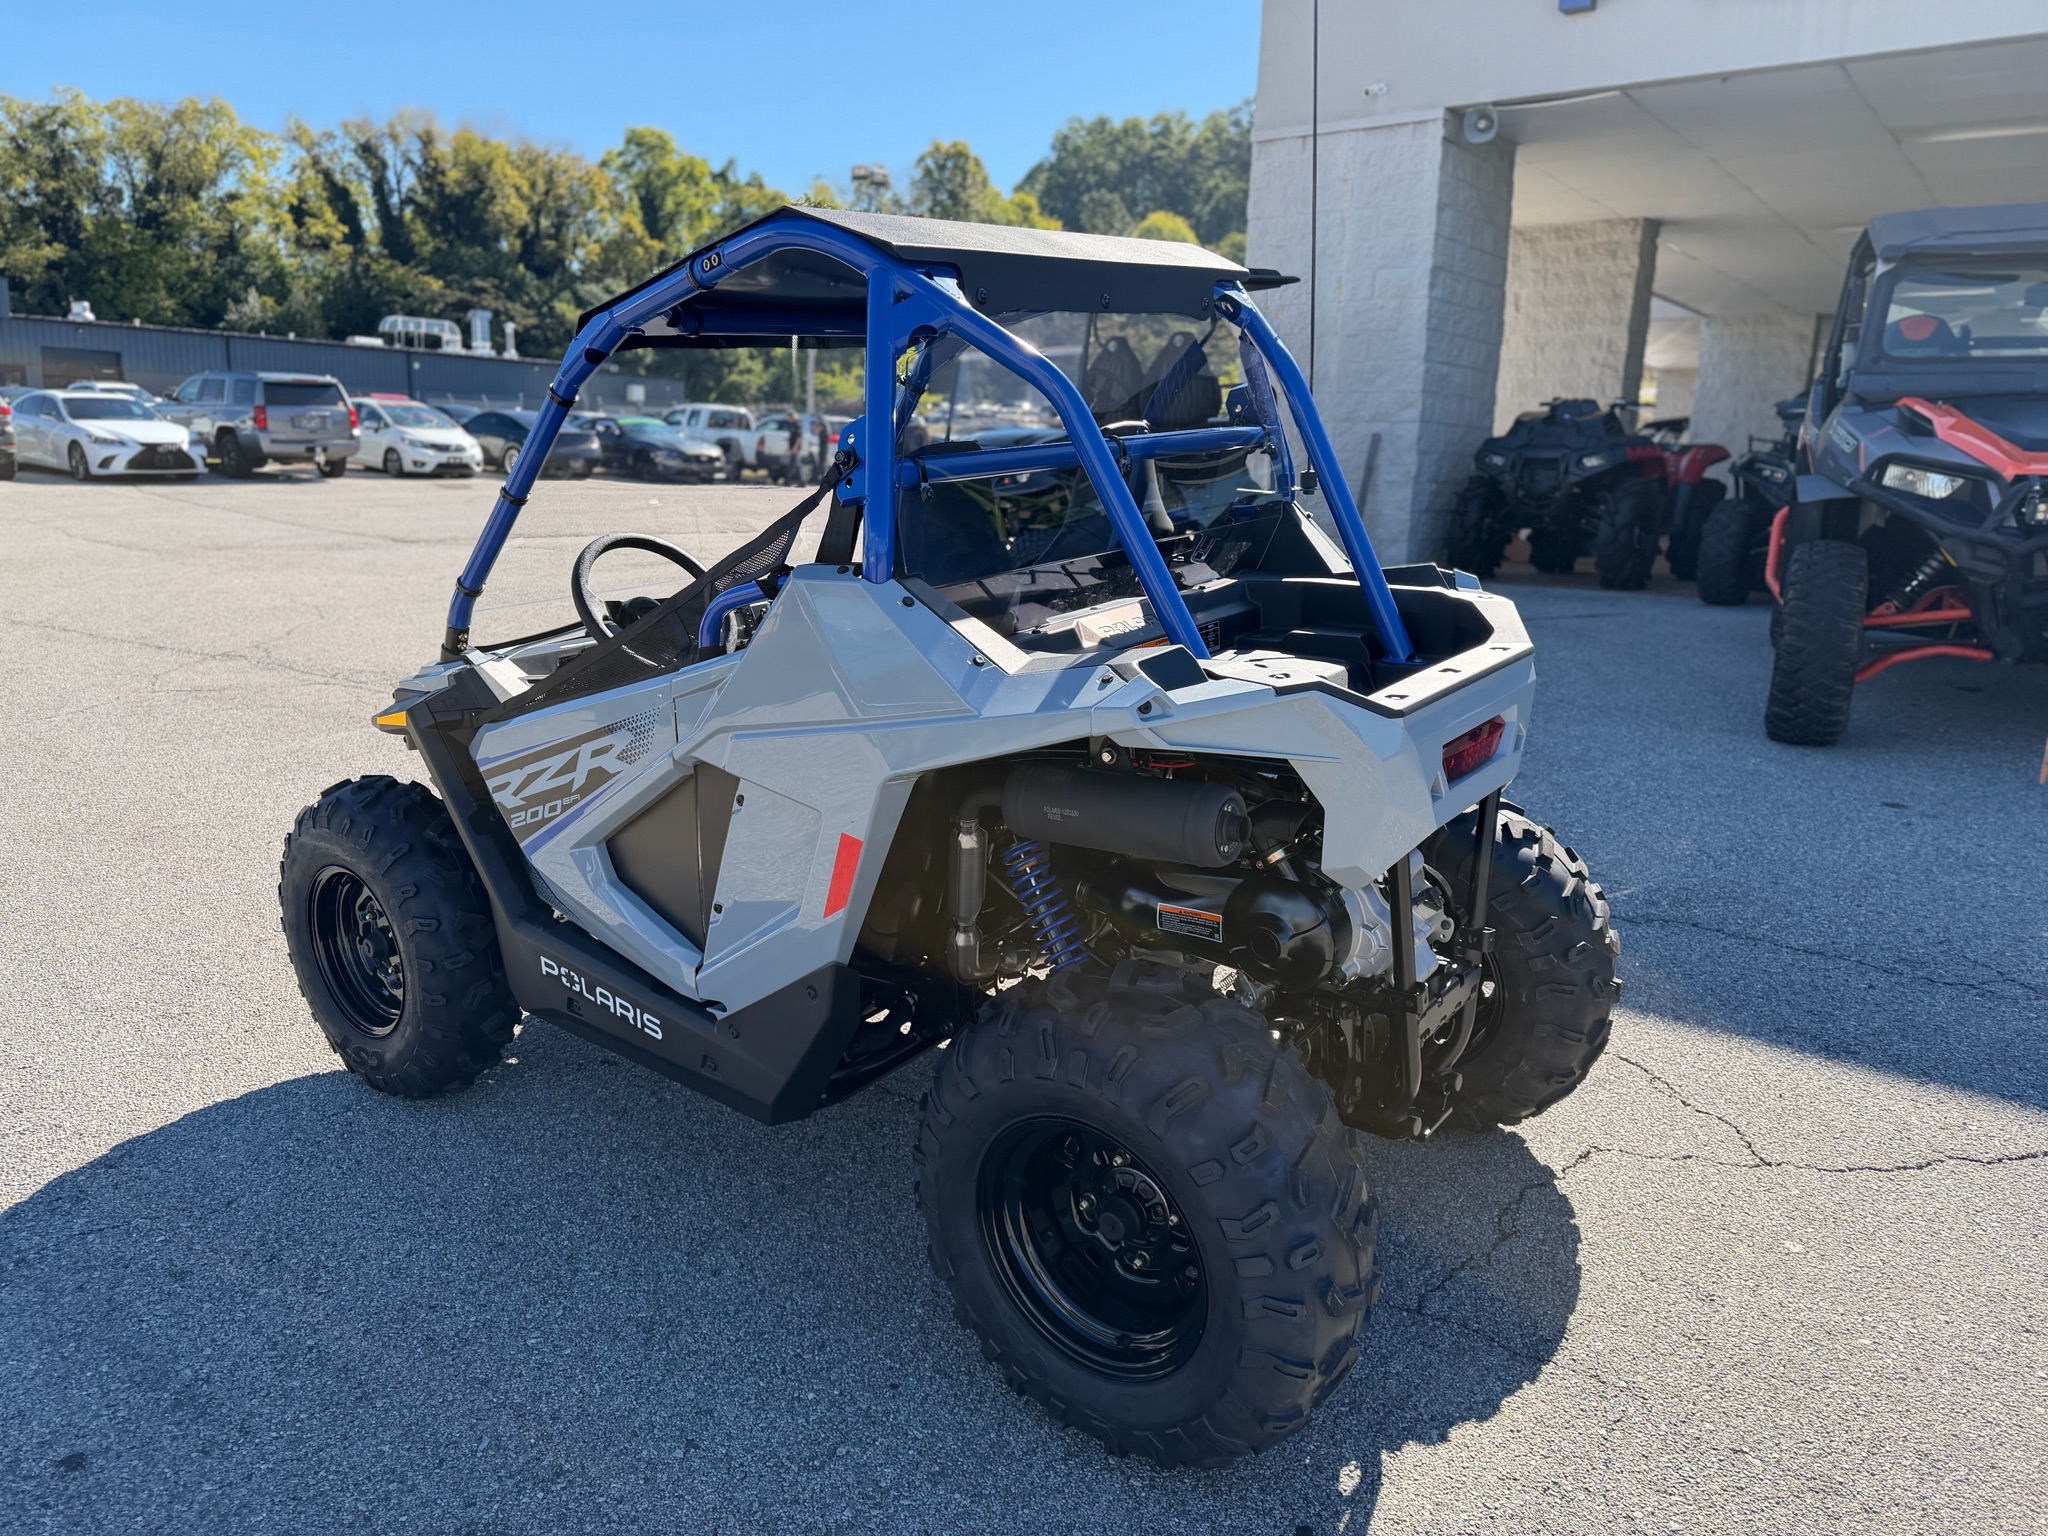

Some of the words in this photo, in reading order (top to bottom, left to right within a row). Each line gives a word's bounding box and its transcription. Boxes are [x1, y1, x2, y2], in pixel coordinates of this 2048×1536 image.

[485, 728, 636, 809] RZR
[510, 799, 563, 829] 200
[540, 955, 663, 1040] POLARIS
